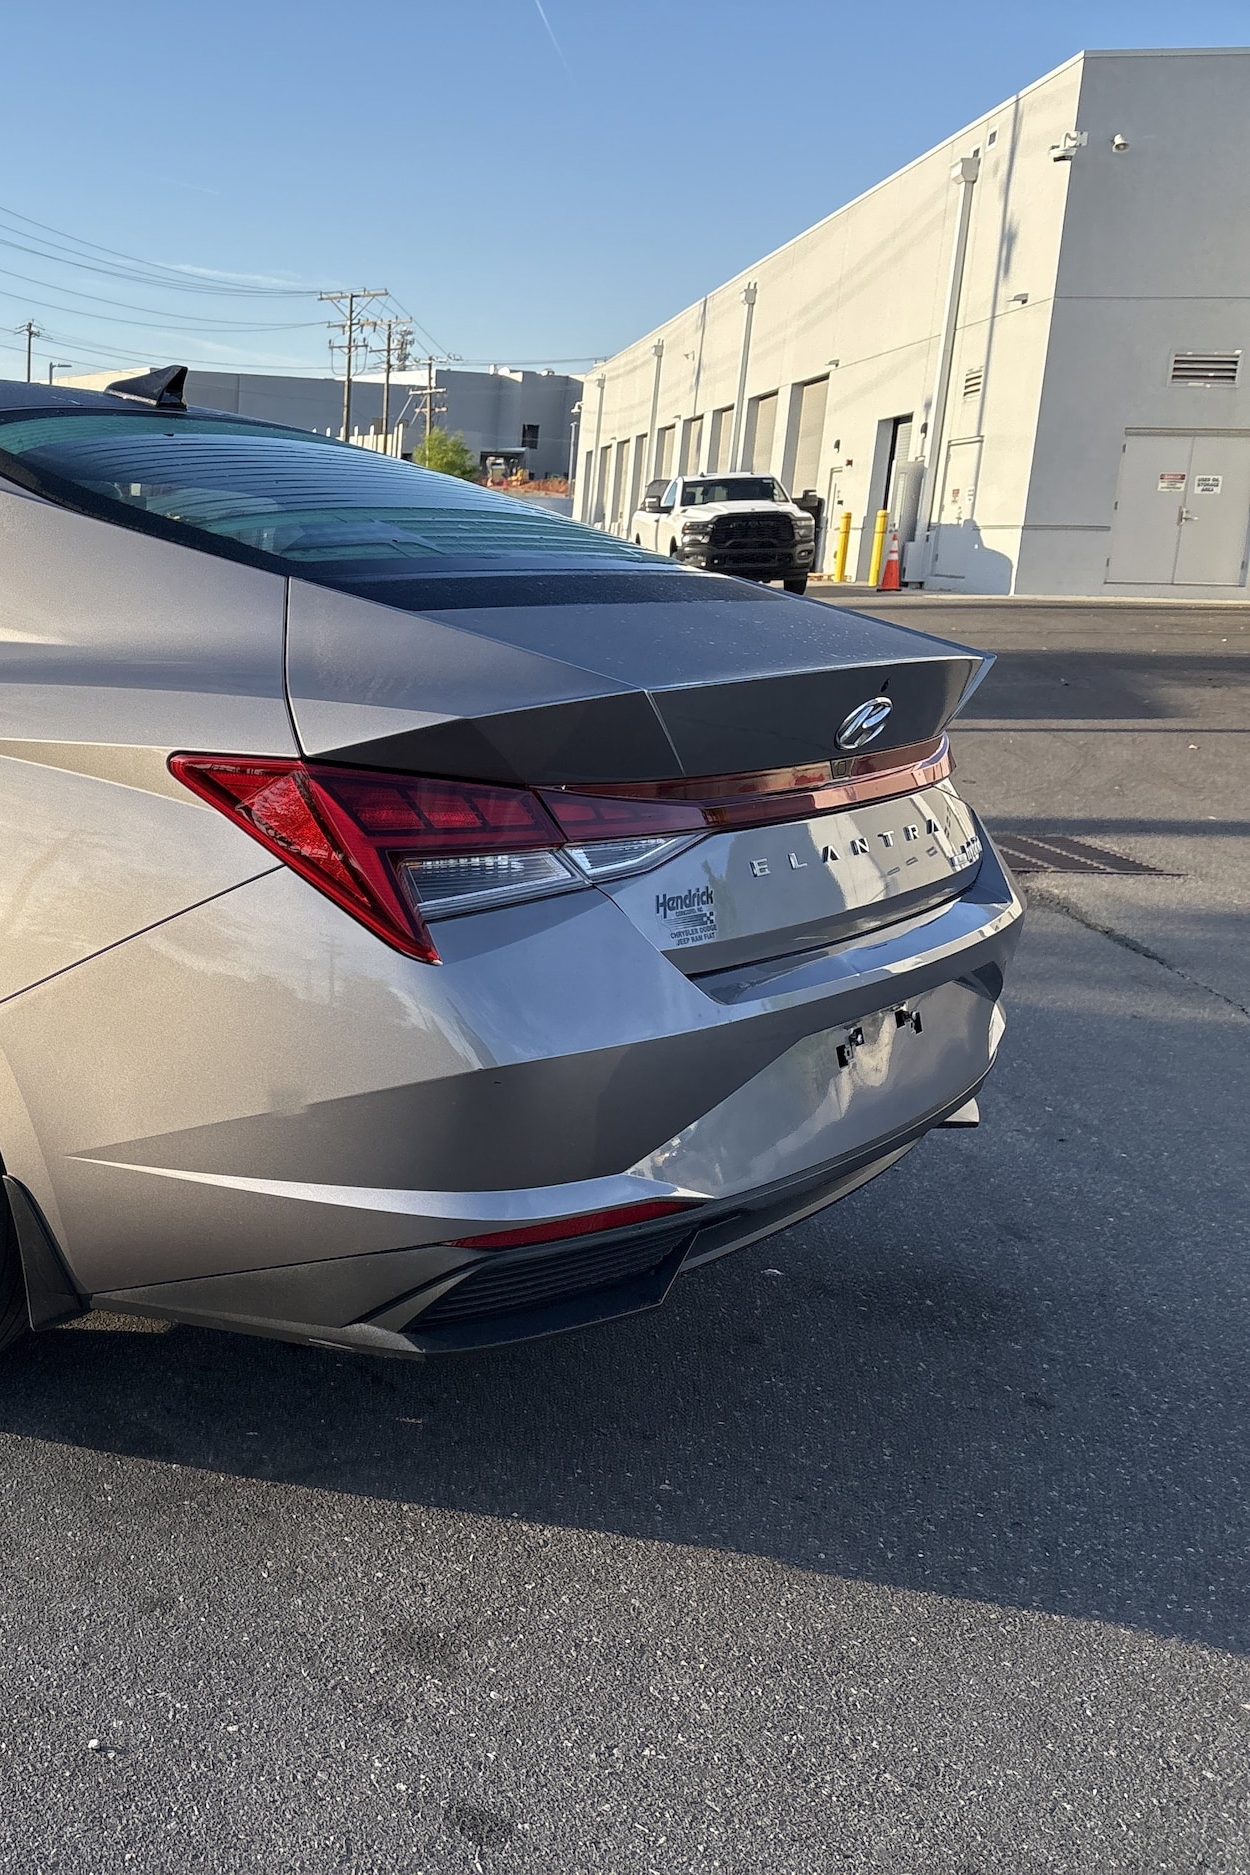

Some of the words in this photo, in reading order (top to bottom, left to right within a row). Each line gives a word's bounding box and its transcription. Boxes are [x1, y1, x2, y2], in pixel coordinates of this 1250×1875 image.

[750, 818, 943, 878] ELANTRA
[655, 886, 714, 919] Hendrick
[670, 928, 699, 939] CHRYSLER
[699, 924, 718, 934] DODGE
[677, 937, 690, 946] JEEP
[691, 935, 704, 943] RAM
[703, 932, 716, 940] FIAT
